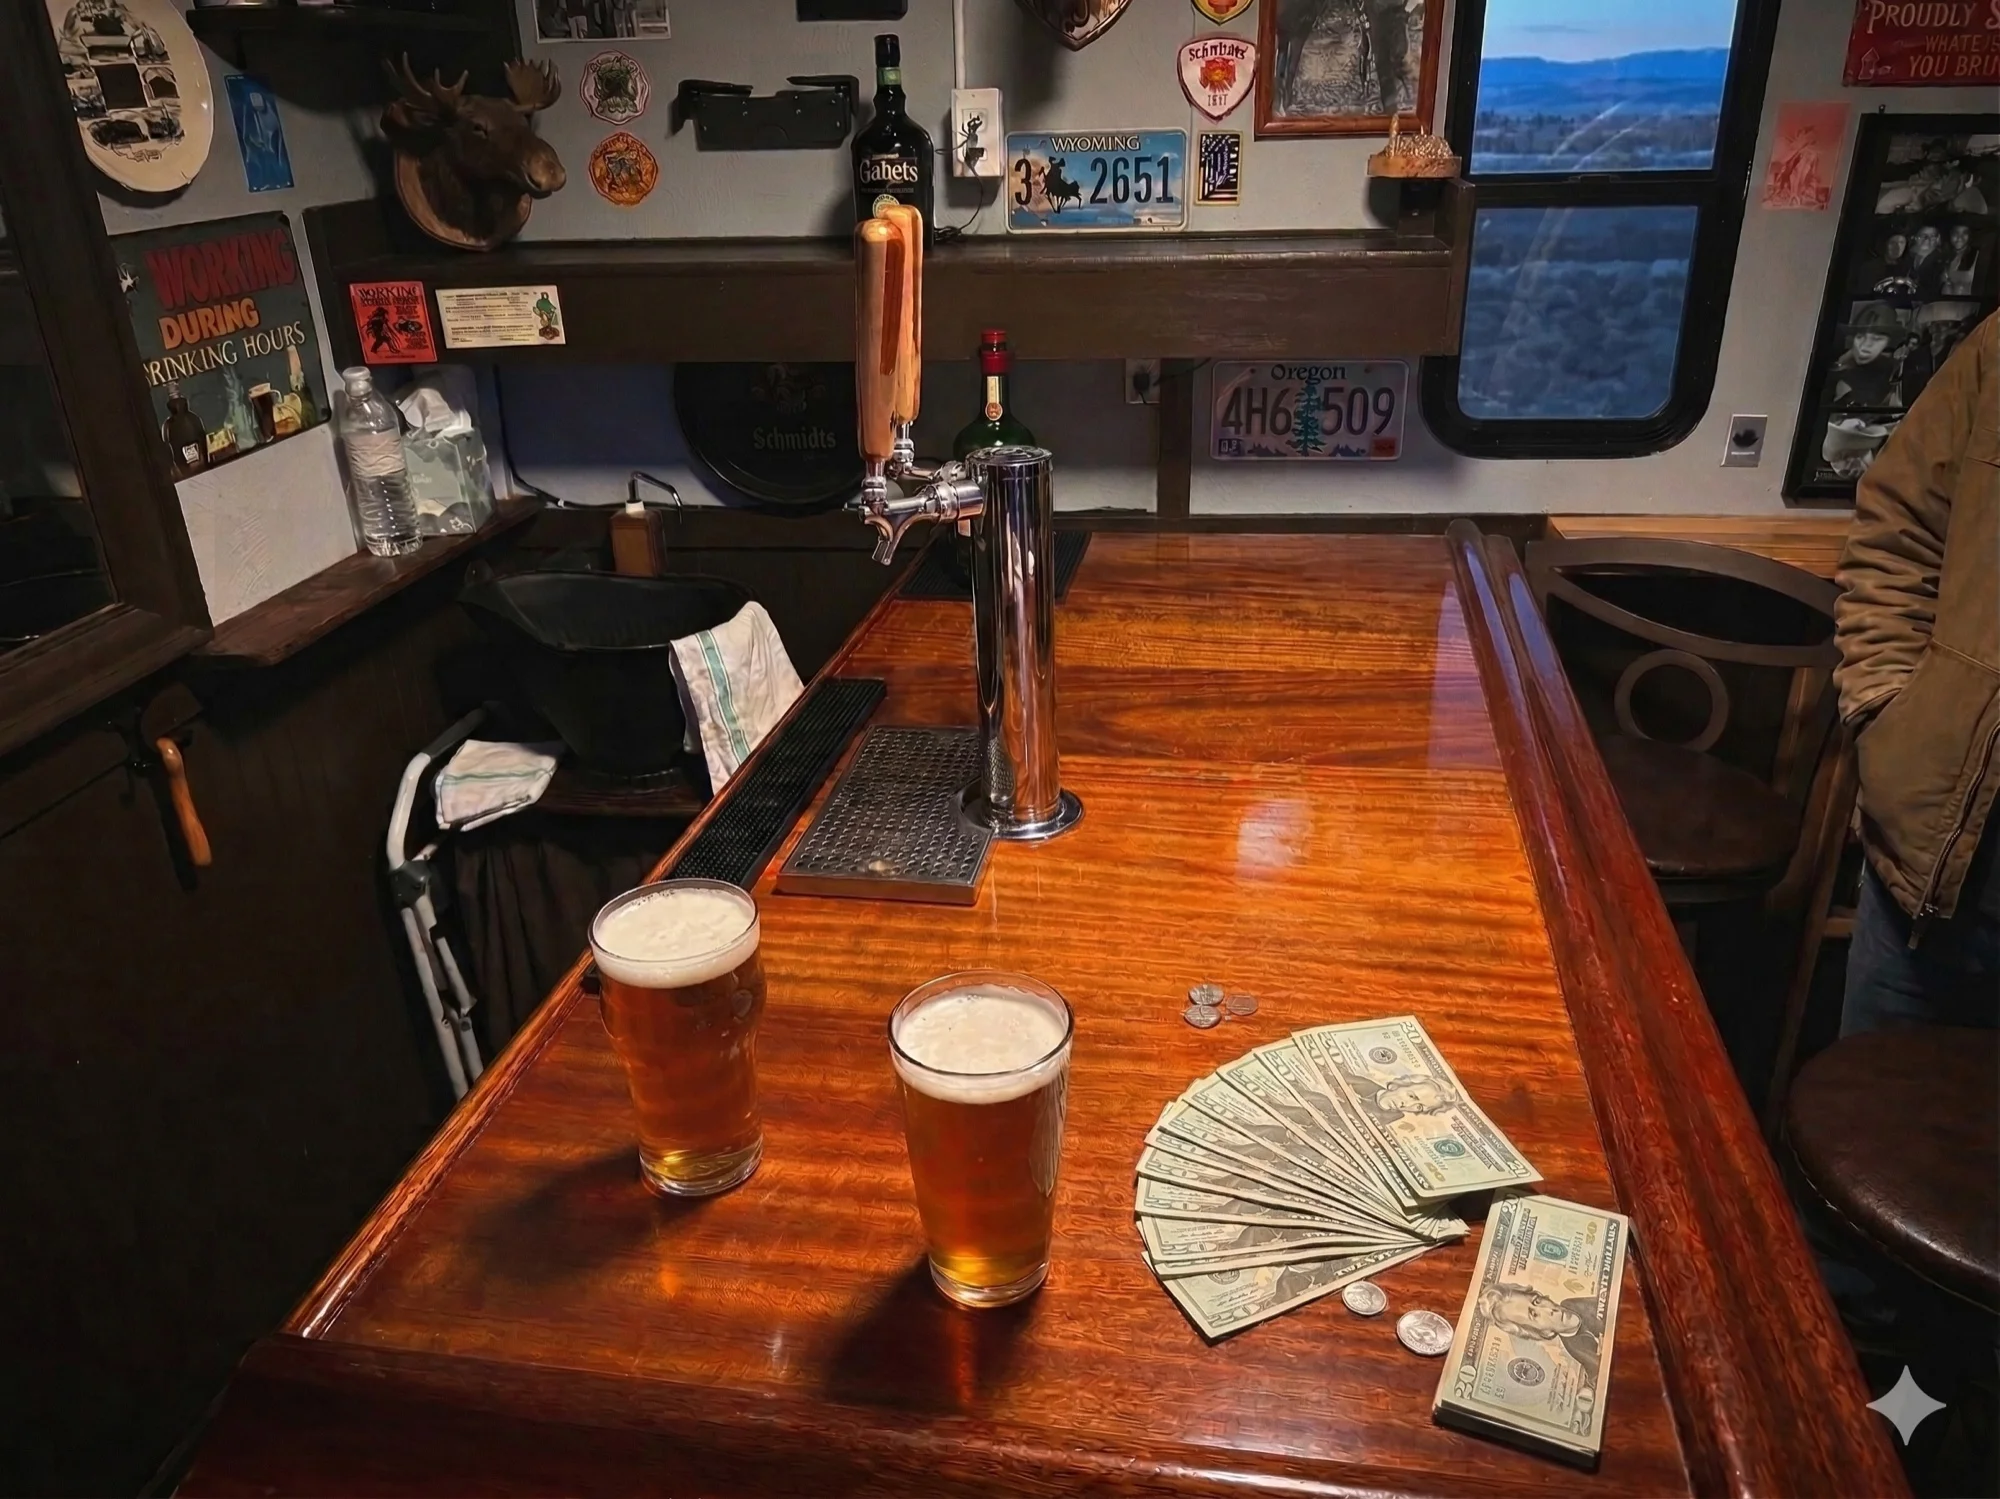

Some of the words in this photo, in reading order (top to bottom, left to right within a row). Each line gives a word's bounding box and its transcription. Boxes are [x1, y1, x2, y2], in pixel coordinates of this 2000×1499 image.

[1867, 0, 1977, 34] PROUDLY
[1909, 55, 1949, 78] YOU
[1051, 136, 1140, 152] WYOMING
[1014, 158, 1033, 206] 3
[1089, 156, 1174, 204] 2651
[146, 229, 297, 310] WORKING
[158, 298, 260, 350] DURING
[143, 340, 238, 388] RINKING
[242, 320, 306, 359] HOURS
[1271, 364, 1347, 385] Oregon
[1221, 387, 1292, 436] 4H6
[1321, 386, 1395, 436] 509
[753, 426, 837, 451] Schmidts
